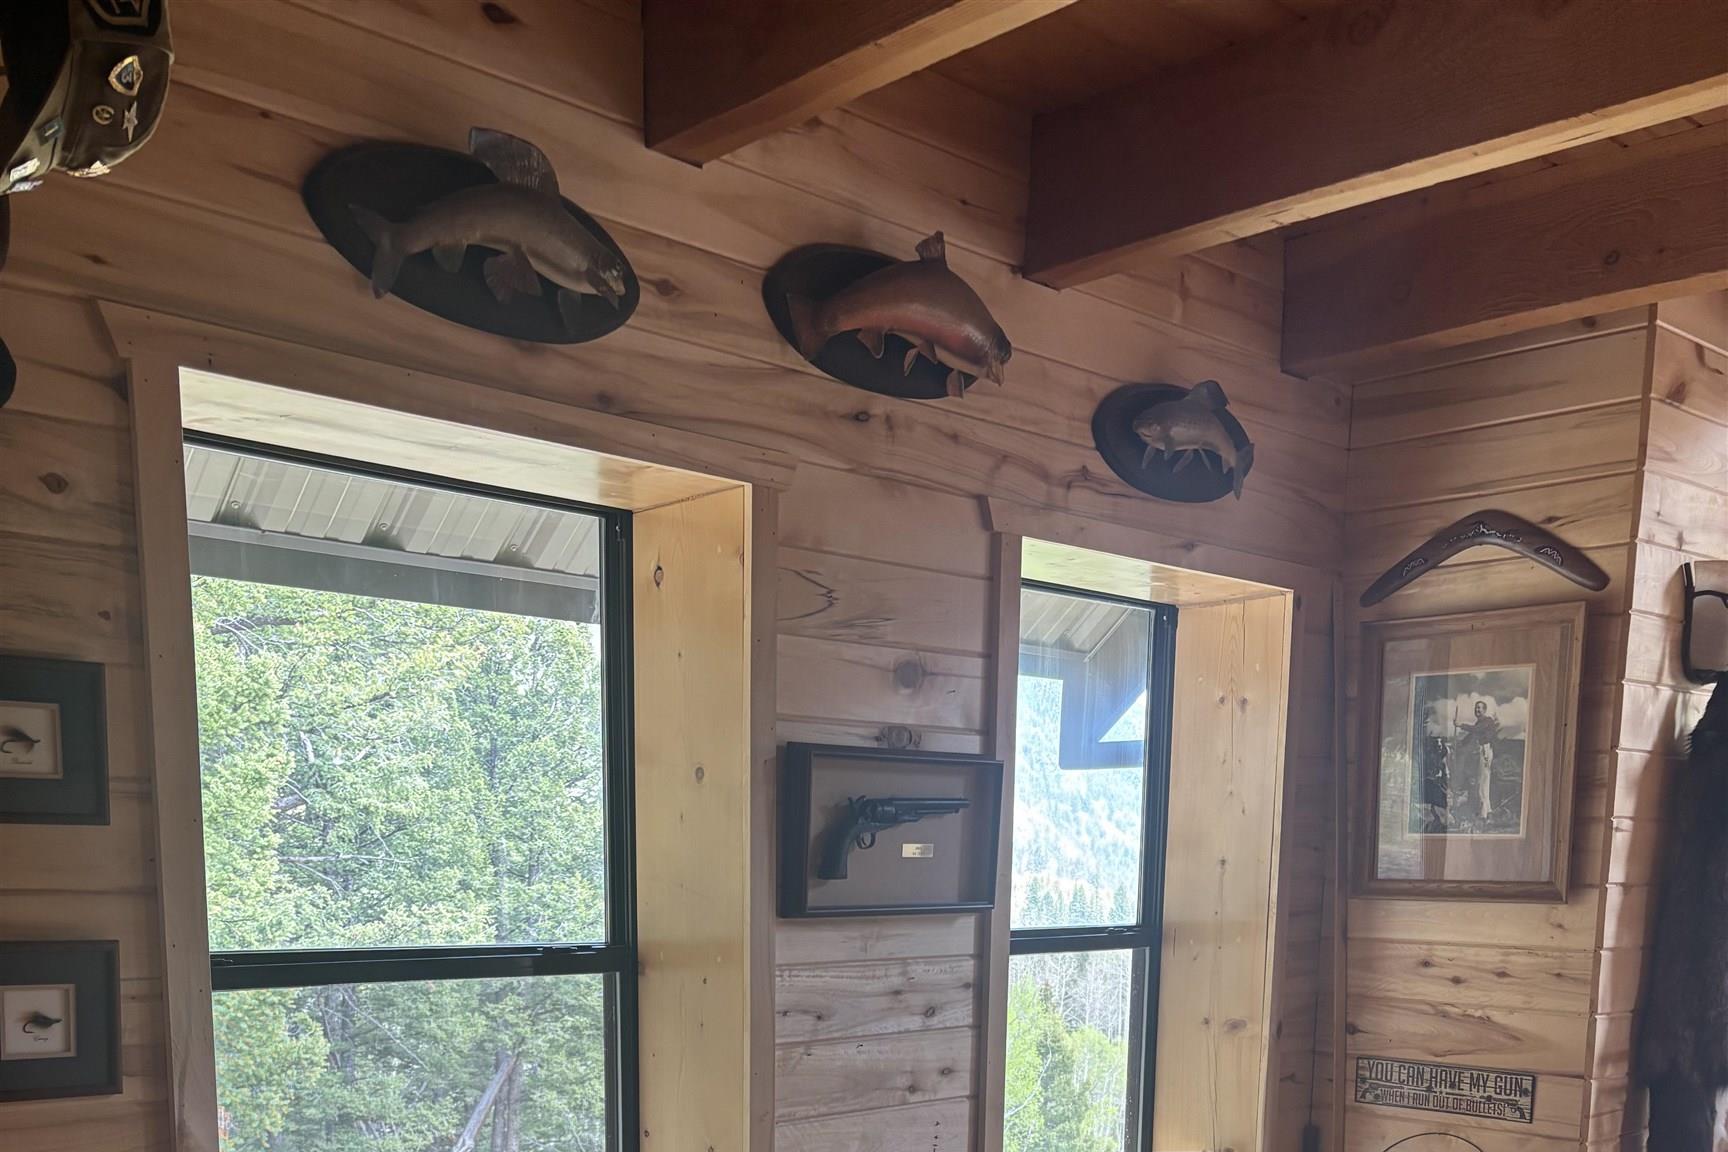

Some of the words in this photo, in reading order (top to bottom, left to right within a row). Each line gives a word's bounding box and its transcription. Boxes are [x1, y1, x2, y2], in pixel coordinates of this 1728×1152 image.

[1368, 1060, 1394, 1082] YOU
[1399, 1063, 1425, 1087] CAN
[1430, 1067, 1465, 1092] HAVE
[1470, 1071, 1490, 1094] MY
[1494, 1075, 1524, 1098] GUN
[1380, 1088, 1404, 1104] WHEN
[1412, 1091, 1430, 1107] RUN
[1432, 1094, 1450, 1110] OUT
[1452, 1096, 1465, 1111] OF
